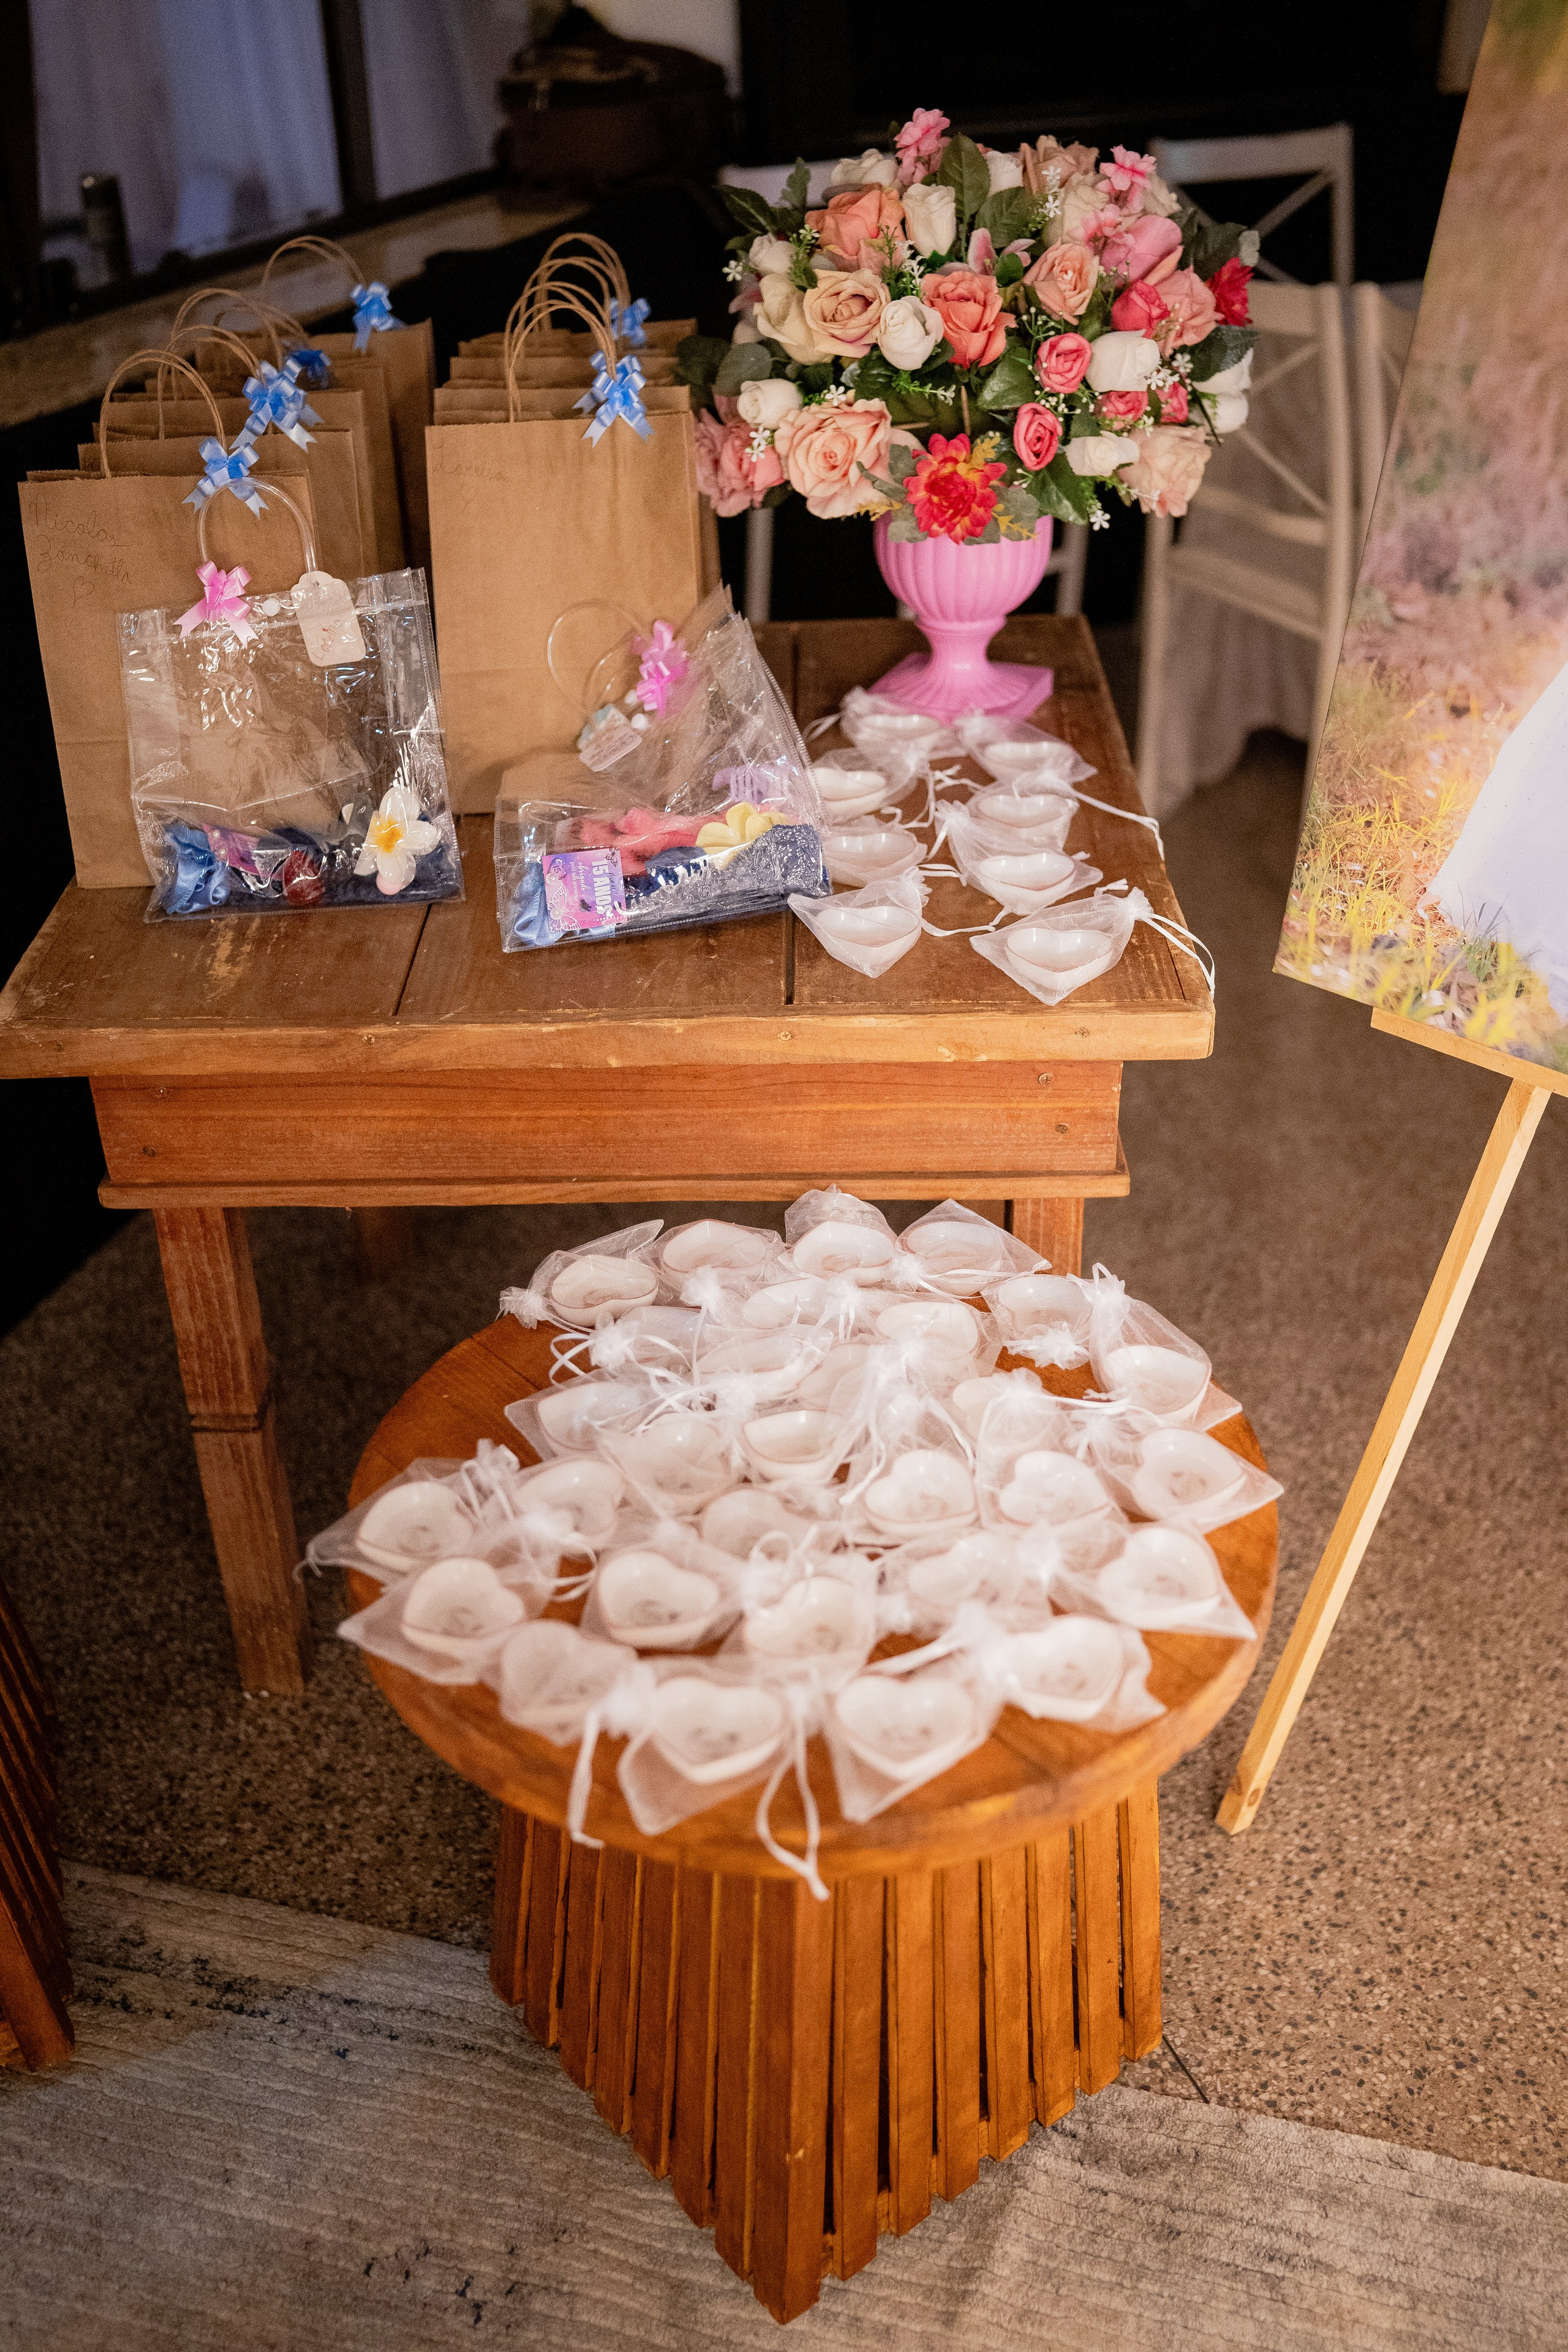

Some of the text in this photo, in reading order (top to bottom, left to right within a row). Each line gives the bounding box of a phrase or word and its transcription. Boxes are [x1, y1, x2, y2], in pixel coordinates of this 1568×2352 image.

[576, 862, 591, 892] obrigado
[592, 860, 613, 915] 15 ANOS
